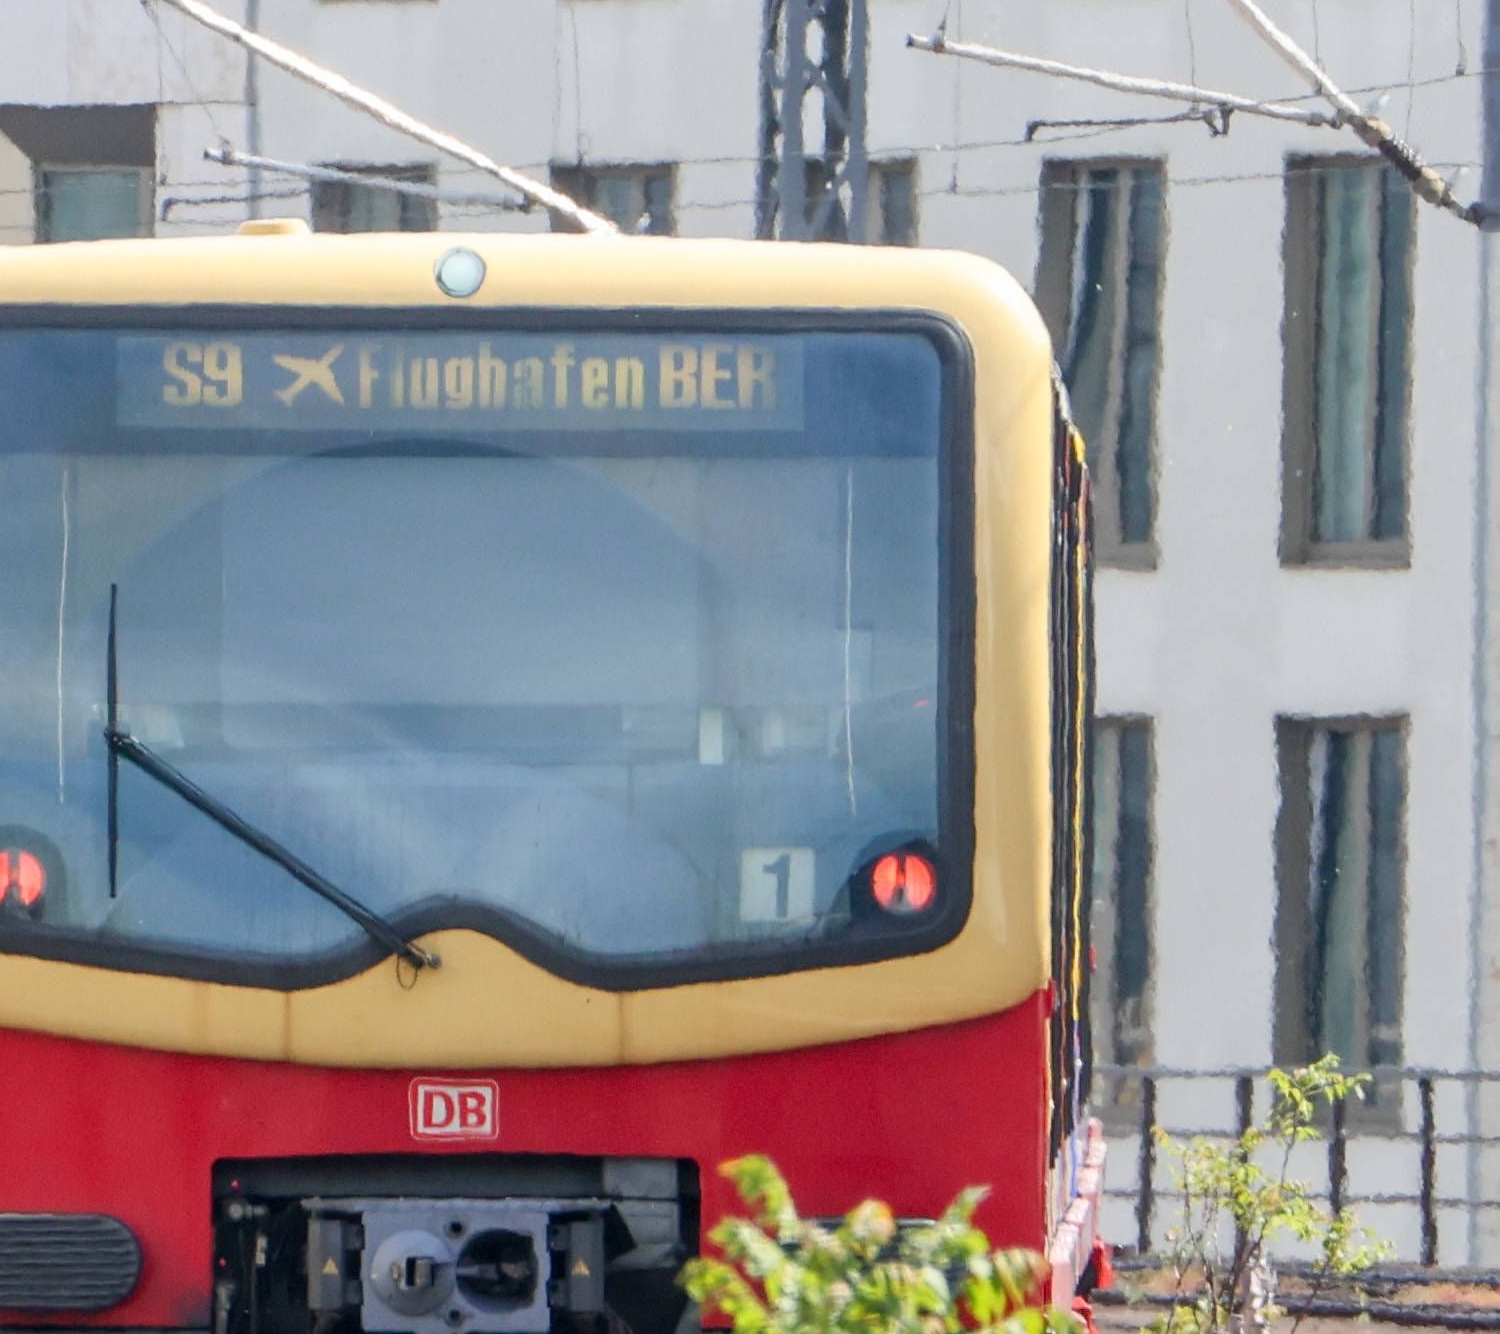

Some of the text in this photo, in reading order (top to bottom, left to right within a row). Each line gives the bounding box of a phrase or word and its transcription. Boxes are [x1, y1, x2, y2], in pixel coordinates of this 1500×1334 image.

[162, 341, 776, 411] S9 Flughafen BER
[762, 852, 791, 918] 1
[424, 1090, 487, 1129] DB
